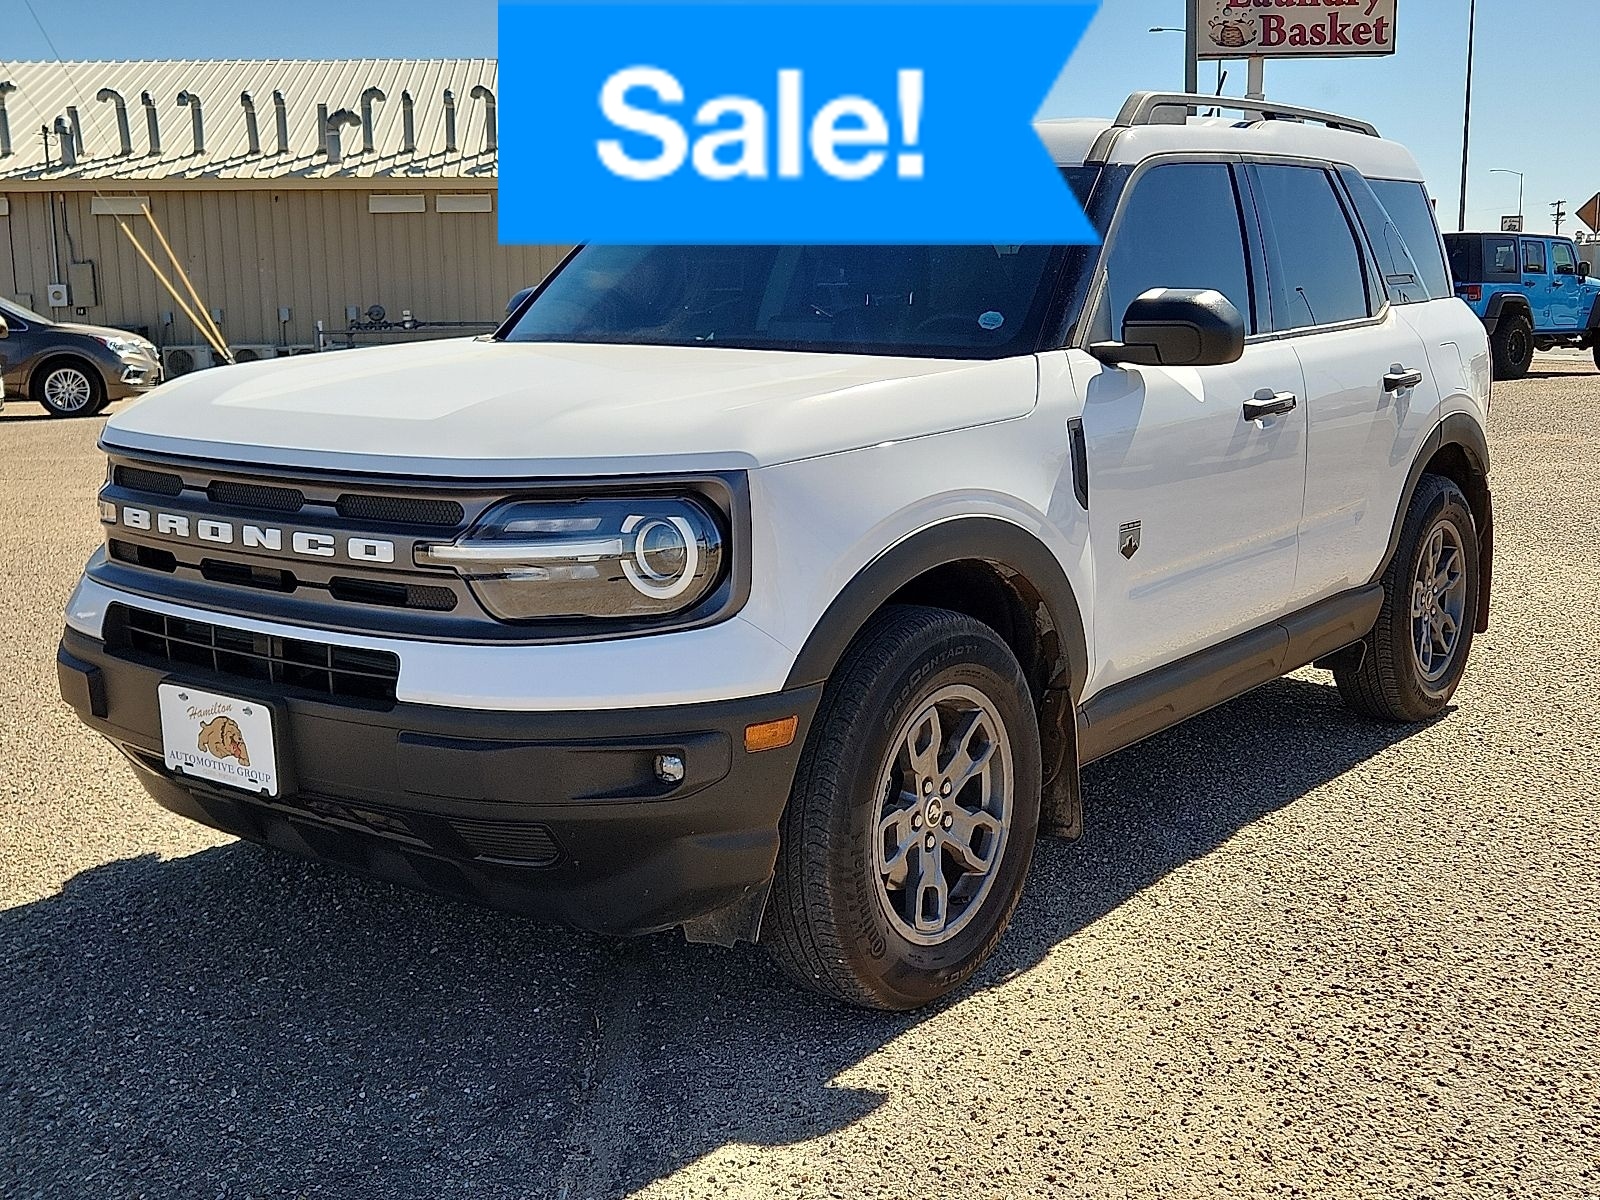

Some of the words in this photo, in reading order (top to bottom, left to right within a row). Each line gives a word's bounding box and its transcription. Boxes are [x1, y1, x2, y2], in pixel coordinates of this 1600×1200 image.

[1258, 12, 1389, 46] Basket
[122, 505, 395, 564] BRONCO
[186, 702, 233, 720] Hamilton
[169, 750, 235, 775] AUTOMOTIVE
[236, 767, 271, 783] GROUP
